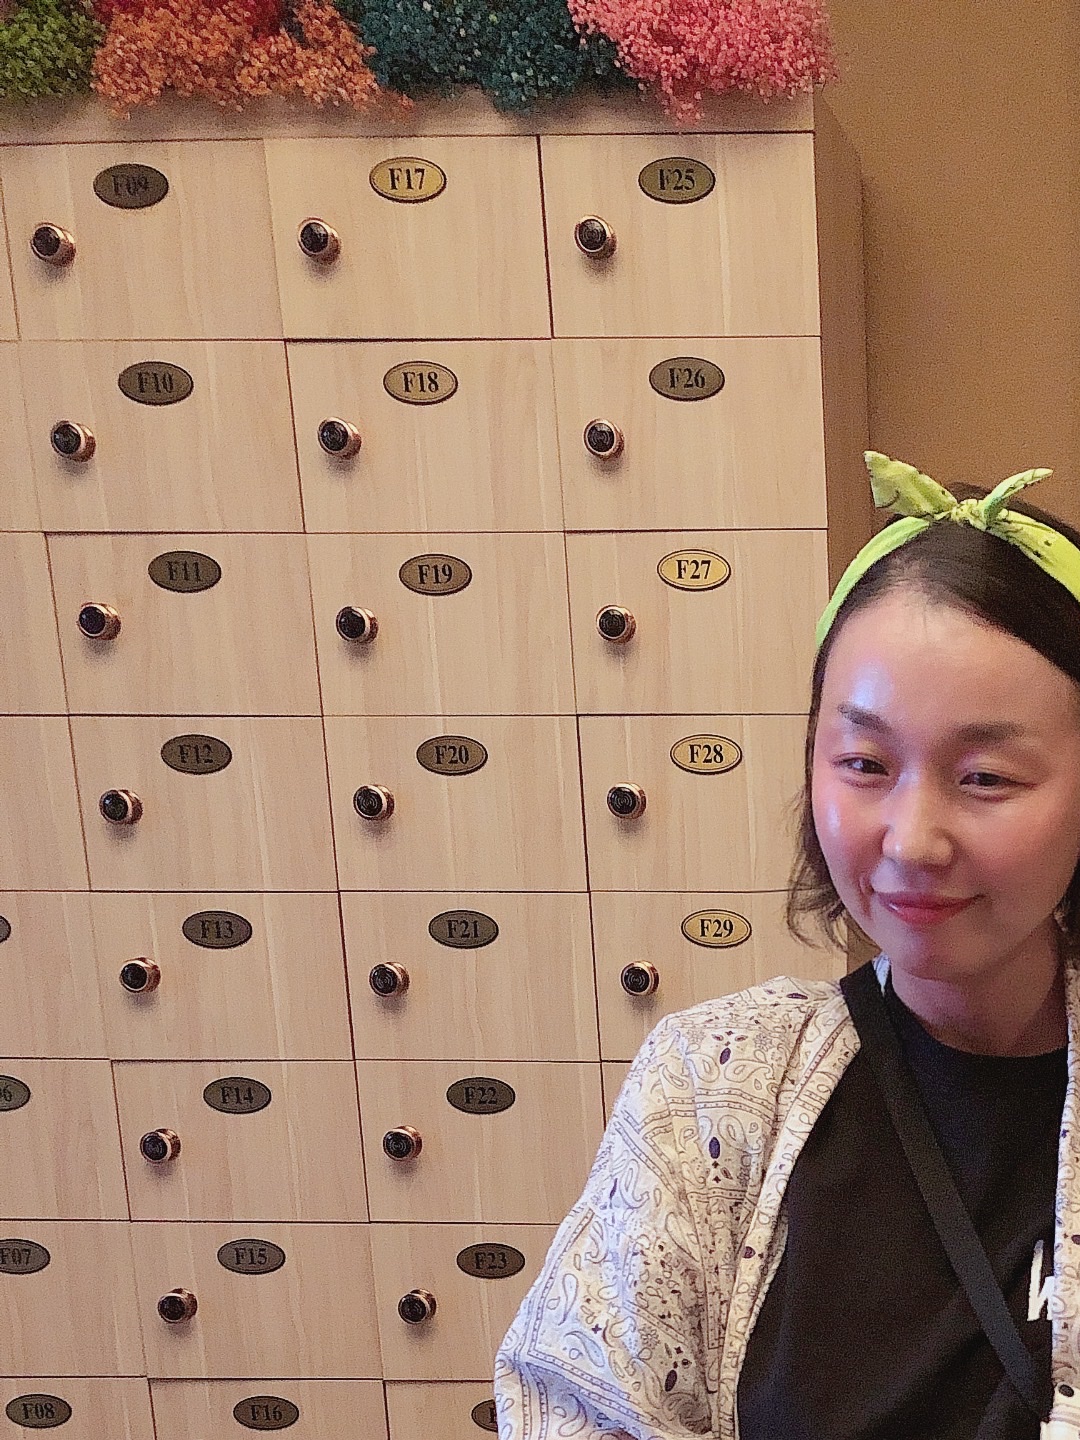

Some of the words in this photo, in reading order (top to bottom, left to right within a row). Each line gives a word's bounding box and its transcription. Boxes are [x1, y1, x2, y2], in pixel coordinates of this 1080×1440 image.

[388, 169, 426, 190] F17
[659, 169, 696, 190] F25
[137, 373, 172, 394] F10
[403, 372, 439, 393] F18
[669, 370, 706, 389] F26
[168, 562, 201, 582] F11
[417, 565, 452, 585] F19
[676, 560, 712, 580] F27
[178, 744, 213, 764] F12
[435, 744, 470, 765] F20
[689, 744, 724, 765] F28
[200, 920, 234, 939] F13
[447, 920, 480, 939] F21
[699, 919, 734, 938] F29
[221, 1086, 254, 1104] F14
[464, 1086, 497, 1105] F22
[0, 1248, 31, 1266] F07
[235, 1248, 267, 1265] F15
[475, 1252, 508, 1269] F23
[23, 1402, 54, 1420] F08
[250, 1404, 282, 1421] F16
